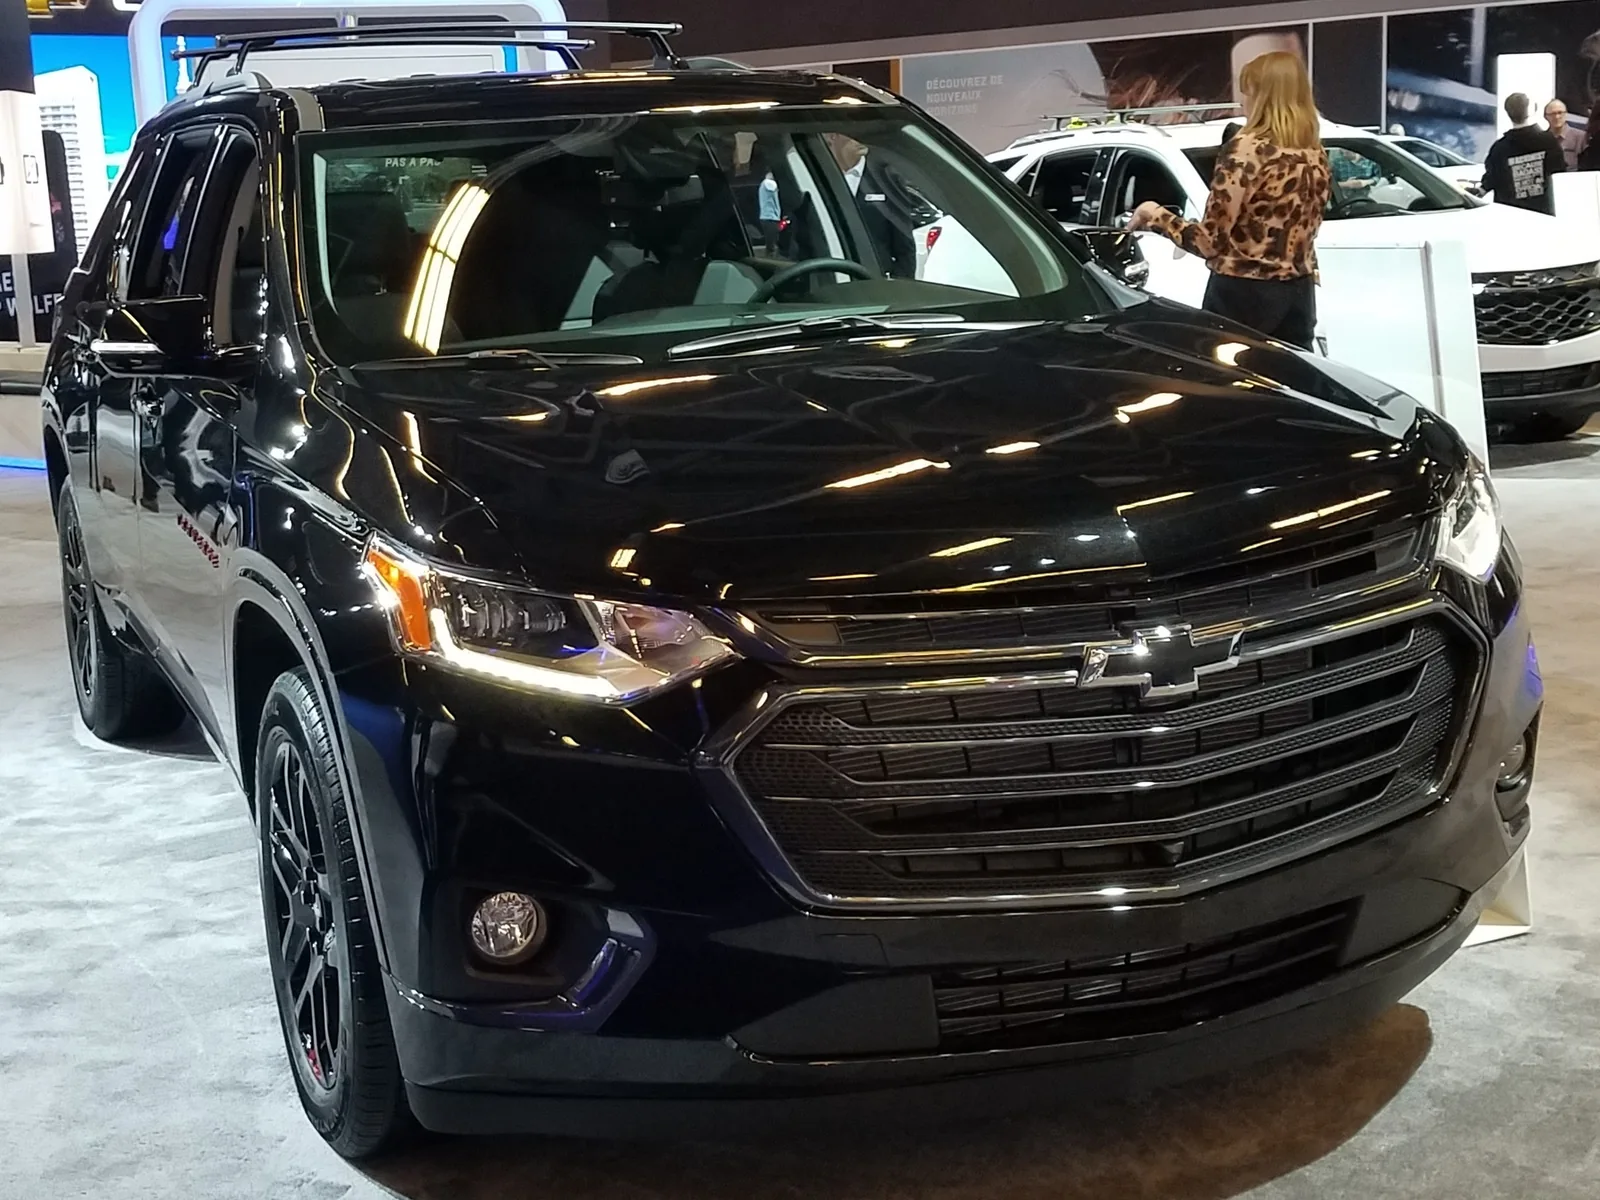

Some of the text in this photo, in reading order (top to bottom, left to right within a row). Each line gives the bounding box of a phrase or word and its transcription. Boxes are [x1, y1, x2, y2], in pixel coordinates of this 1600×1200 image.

[926, 75, 1003, 90] DÉCOUVREZ DE
[926, 90, 981, 103] NOUVEAUX
[0, 272, 13, 293] E
